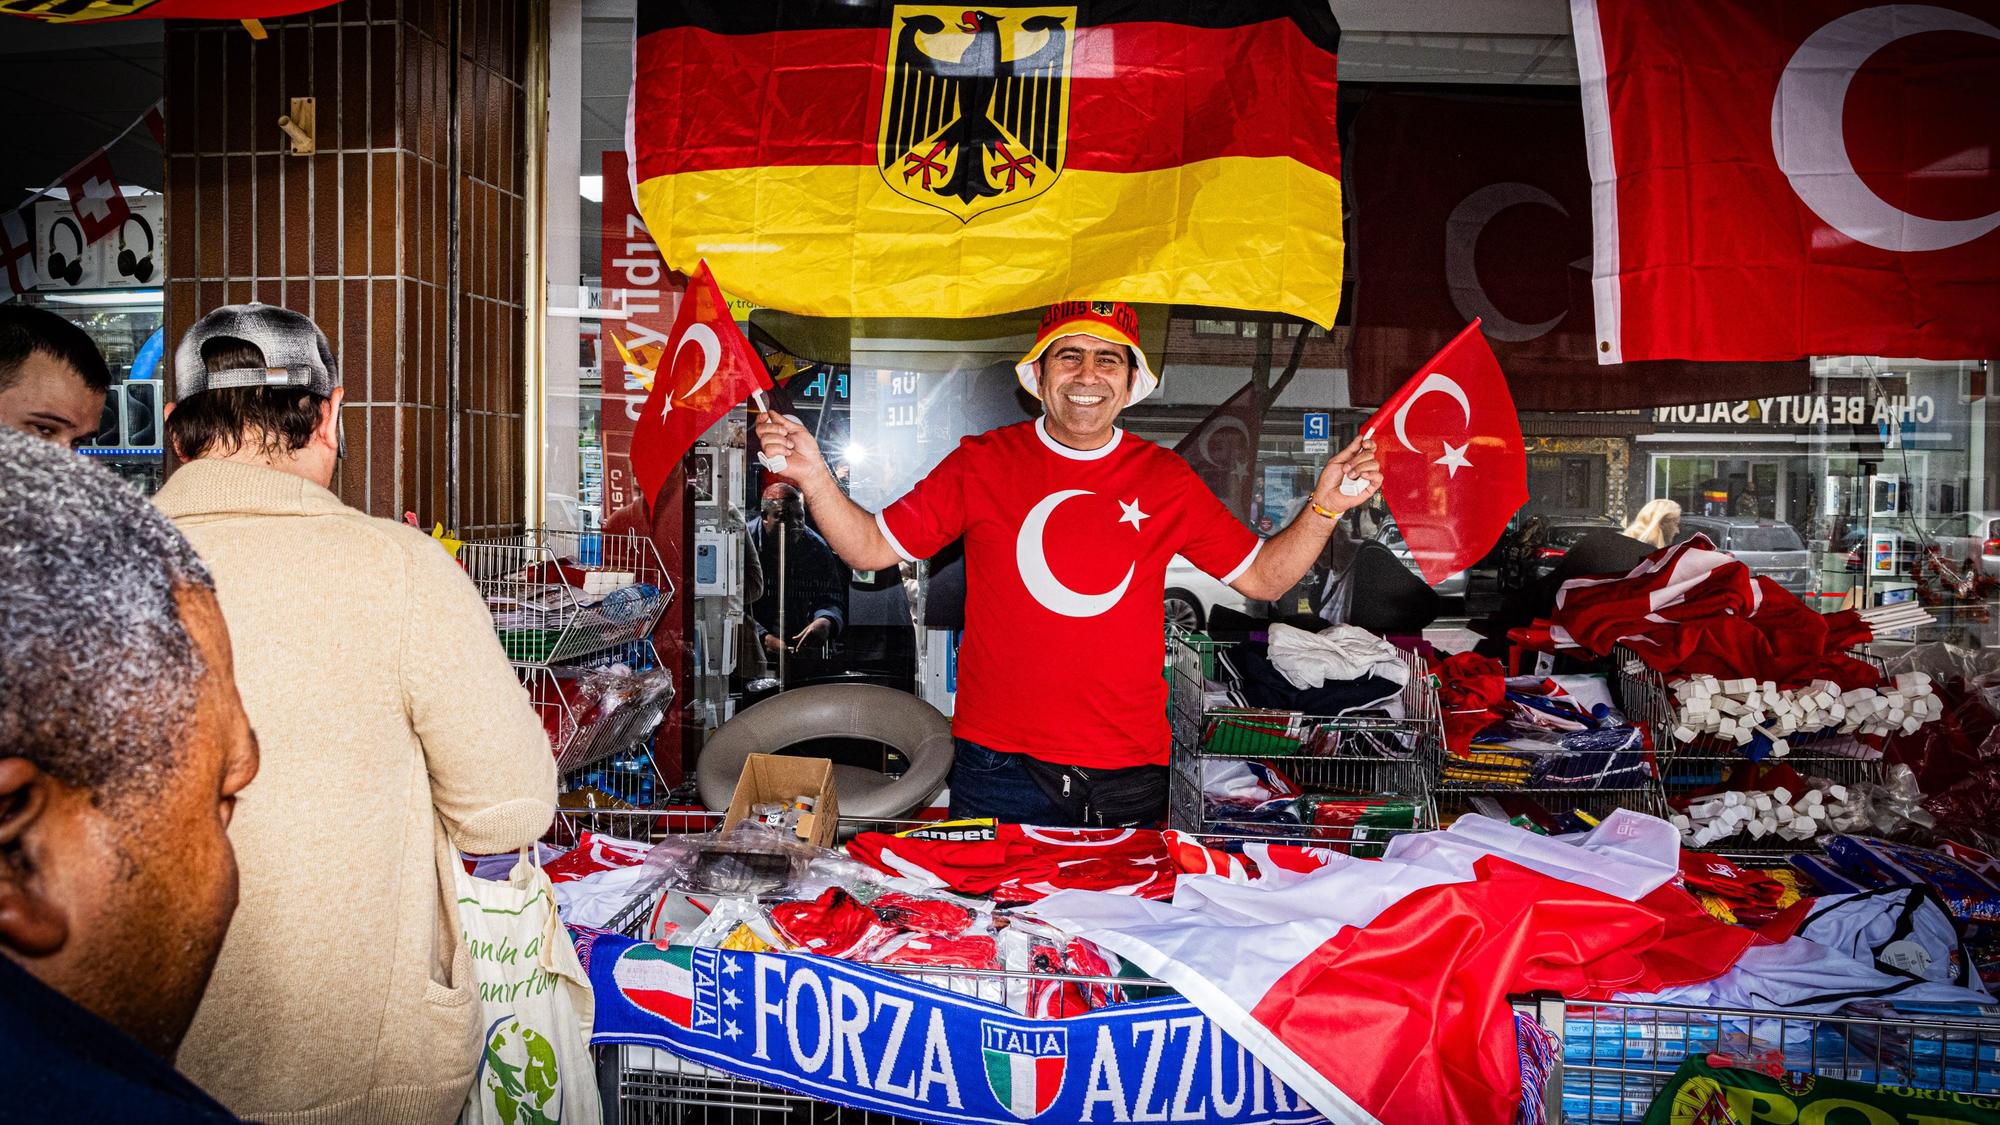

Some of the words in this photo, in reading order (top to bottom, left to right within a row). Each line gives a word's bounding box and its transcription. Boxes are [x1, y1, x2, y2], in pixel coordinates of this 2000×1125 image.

[695, 950, 717, 1027] ITALIA
[752, 953, 965, 1110] FORZA
[987, 1025, 1061, 1055] ITALIA
